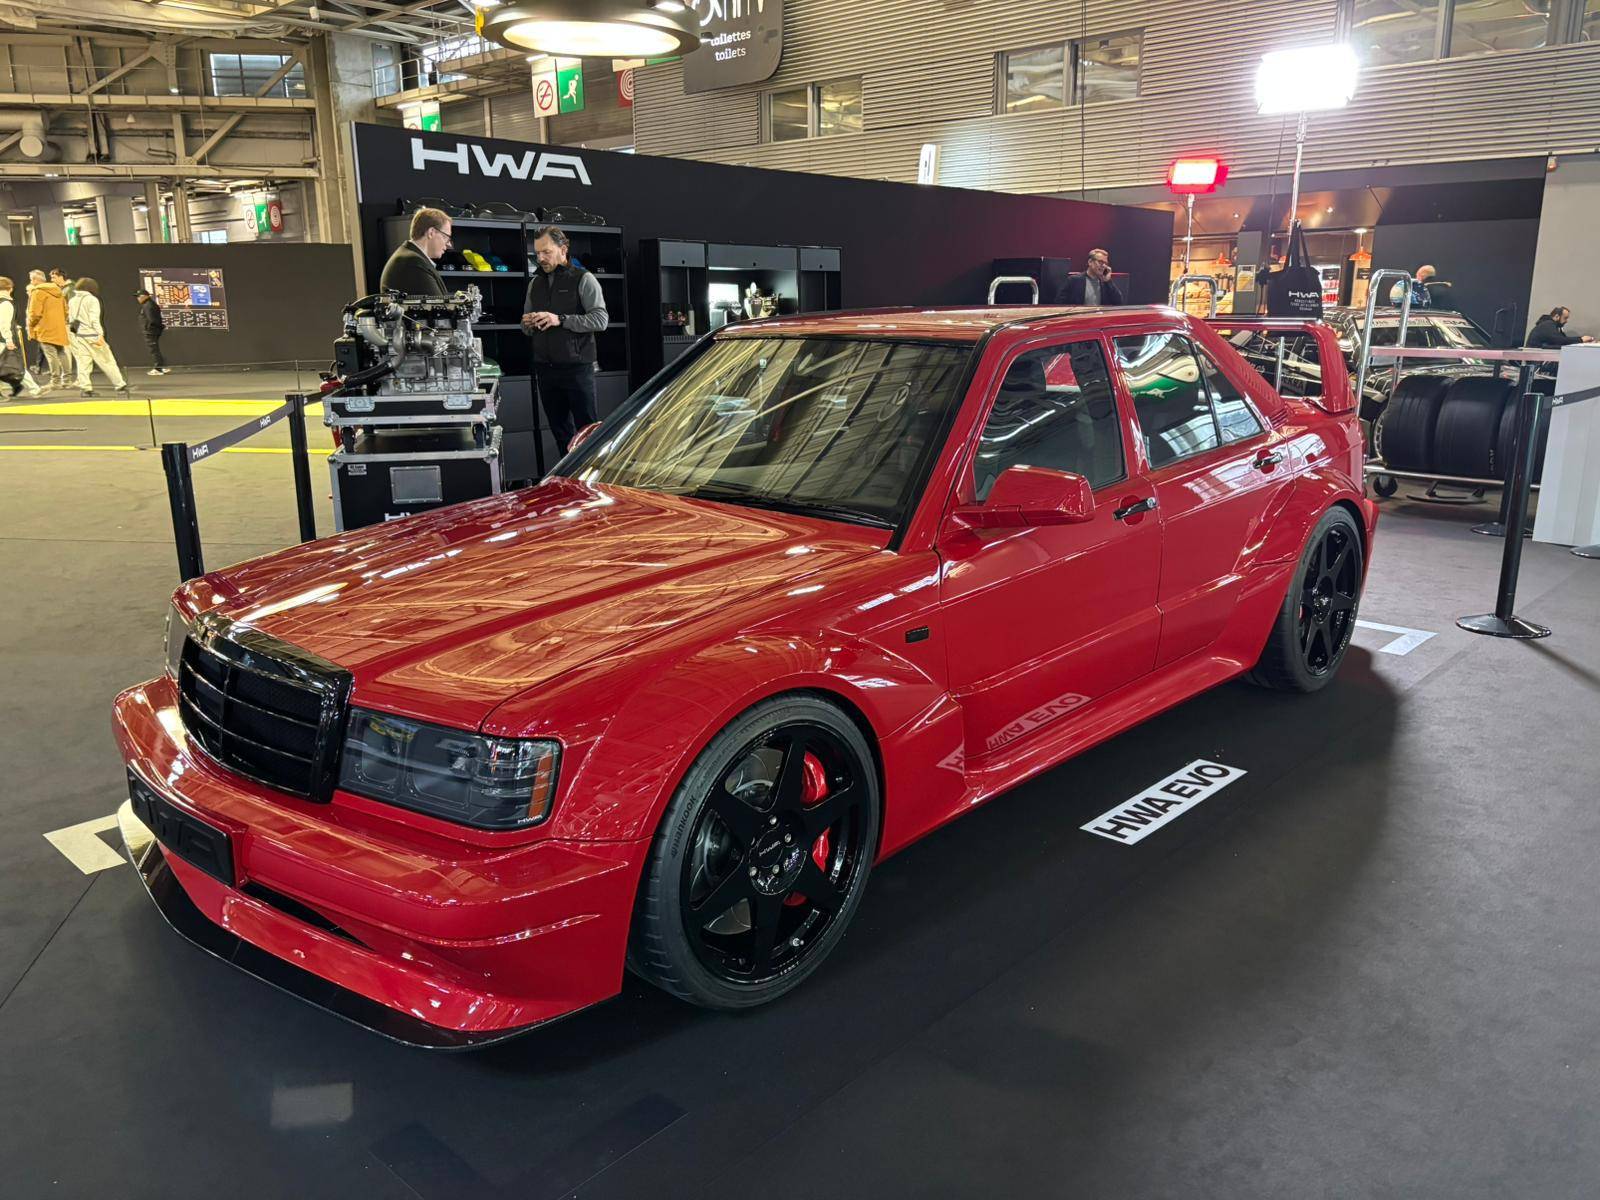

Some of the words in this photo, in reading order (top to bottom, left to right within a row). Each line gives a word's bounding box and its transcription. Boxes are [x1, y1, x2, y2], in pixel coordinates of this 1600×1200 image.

[715, 47, 746, 61] toilets
[411, 138, 592, 185] HWA
[1288, 290, 1319, 298] HWA
[192, 444, 209, 460] HWA
[1092, 797, 1183, 840] HWA
[1159, 764, 1231, 799] EVO
